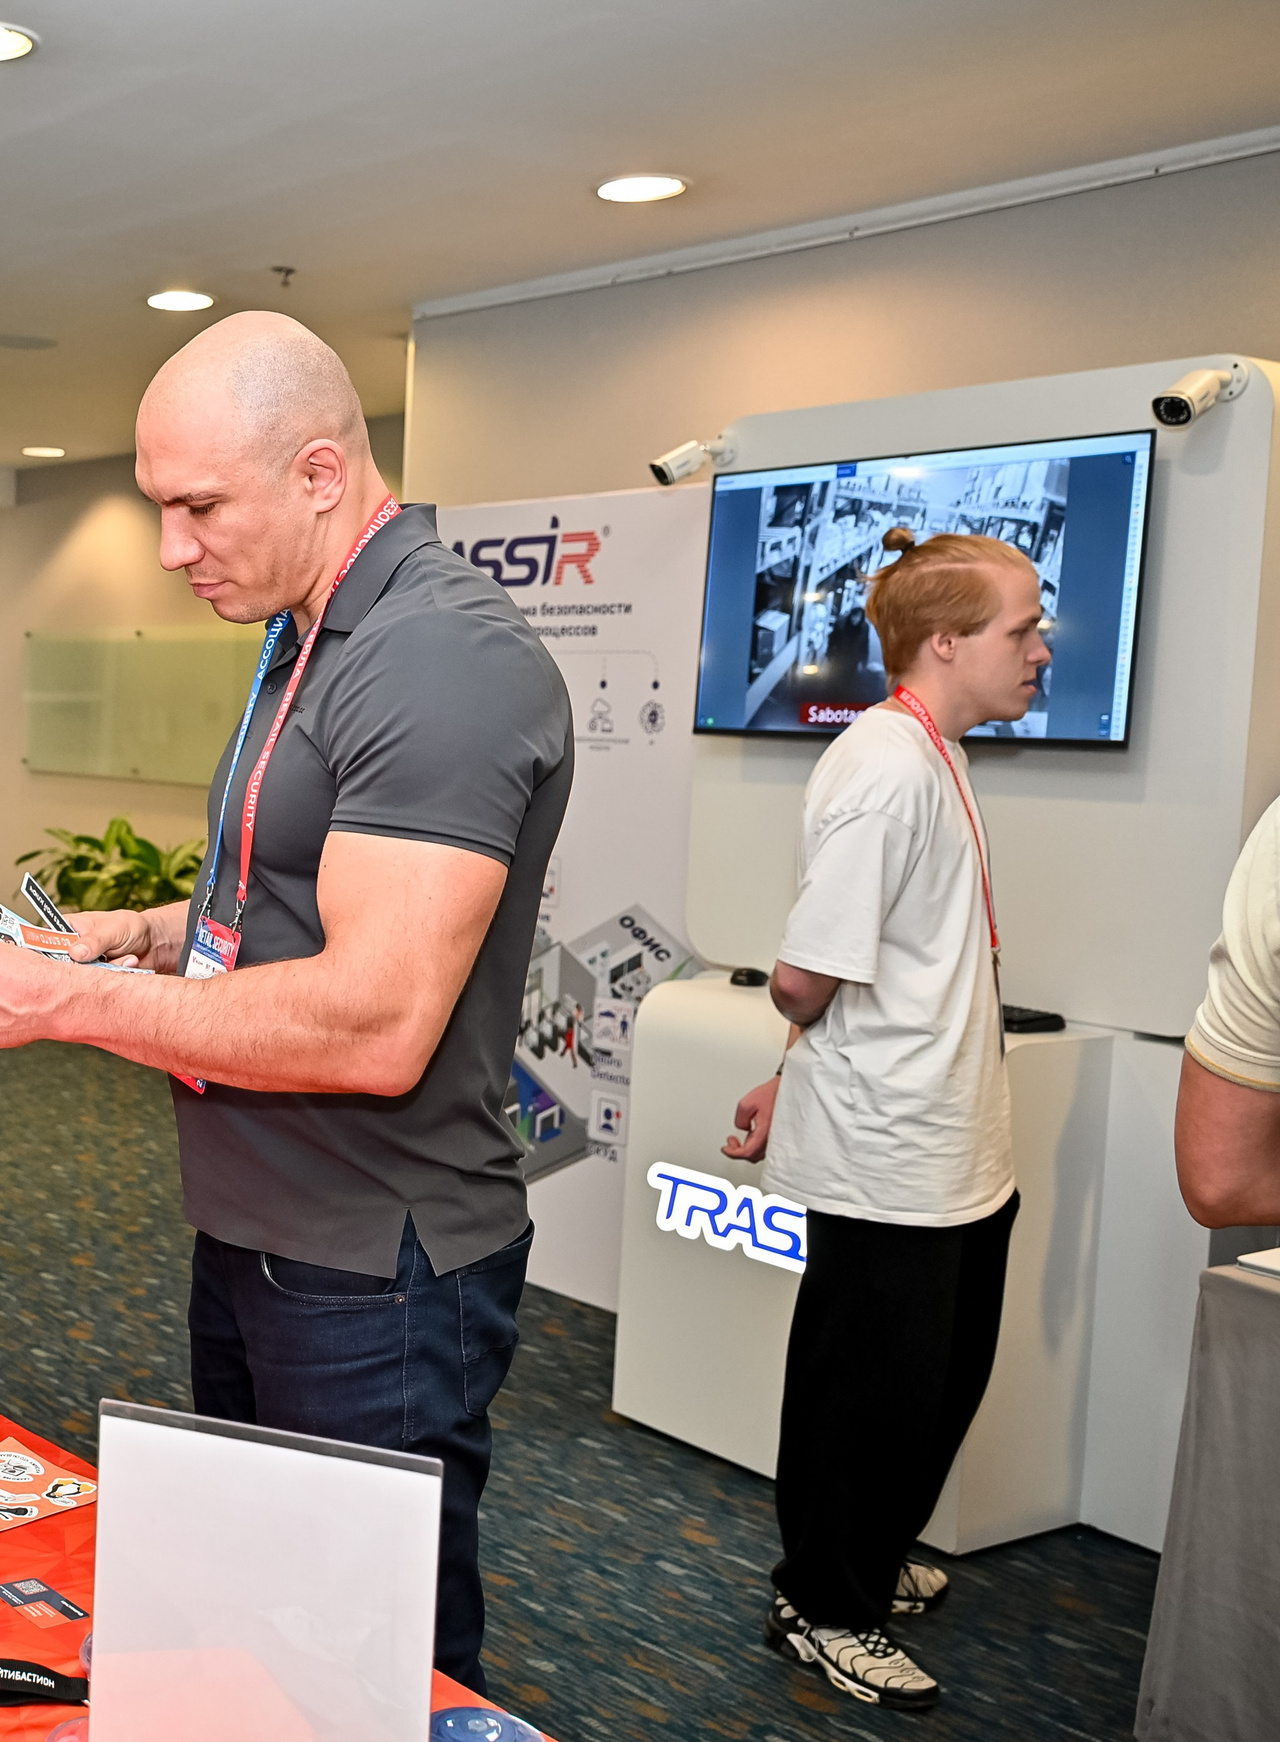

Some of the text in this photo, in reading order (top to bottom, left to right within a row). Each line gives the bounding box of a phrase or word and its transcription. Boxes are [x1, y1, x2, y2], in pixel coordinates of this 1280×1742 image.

[534, 624, 598, 638] роцессов
[541, 601, 633, 617] безопасности
[257, 608, 291, 680] АССОЦИА
[268, 692, 293, 748] RETAIL
[245, 751, 269, 831] SECURITY
[213, 932, 235, 957] SECURITY
[619, 915, 671, 962] ОФИС
[657, 1173, 807, 1262] TRAS
